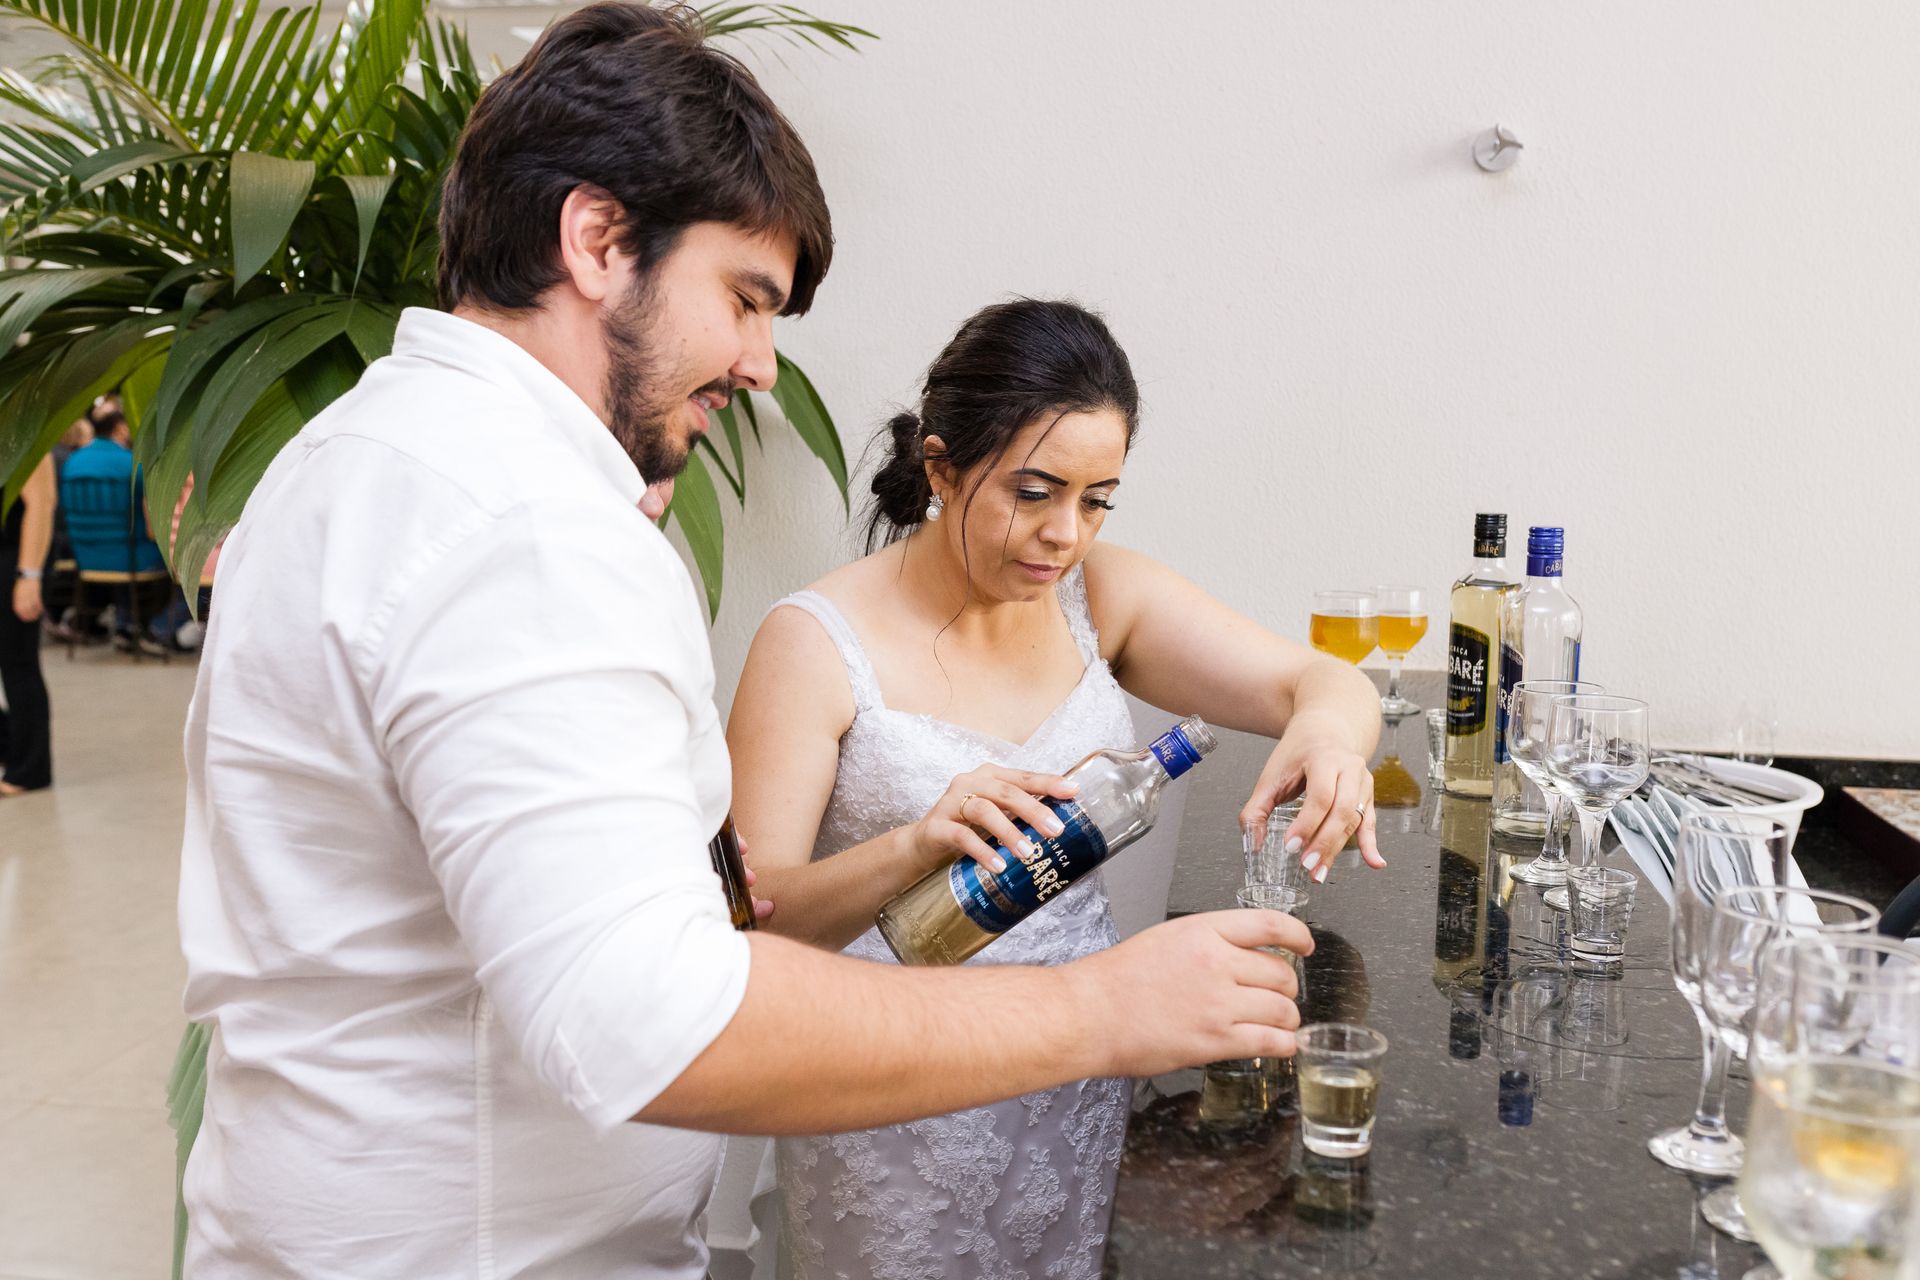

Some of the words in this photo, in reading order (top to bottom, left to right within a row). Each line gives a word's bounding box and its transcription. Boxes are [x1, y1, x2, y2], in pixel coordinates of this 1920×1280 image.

[1448, 655, 1484, 685] BARÉ
[1159, 740, 1177, 764] BARÉ
[1016, 834, 1069, 901] BARÉ
[1046, 836, 1070, 868] CHAÇA
